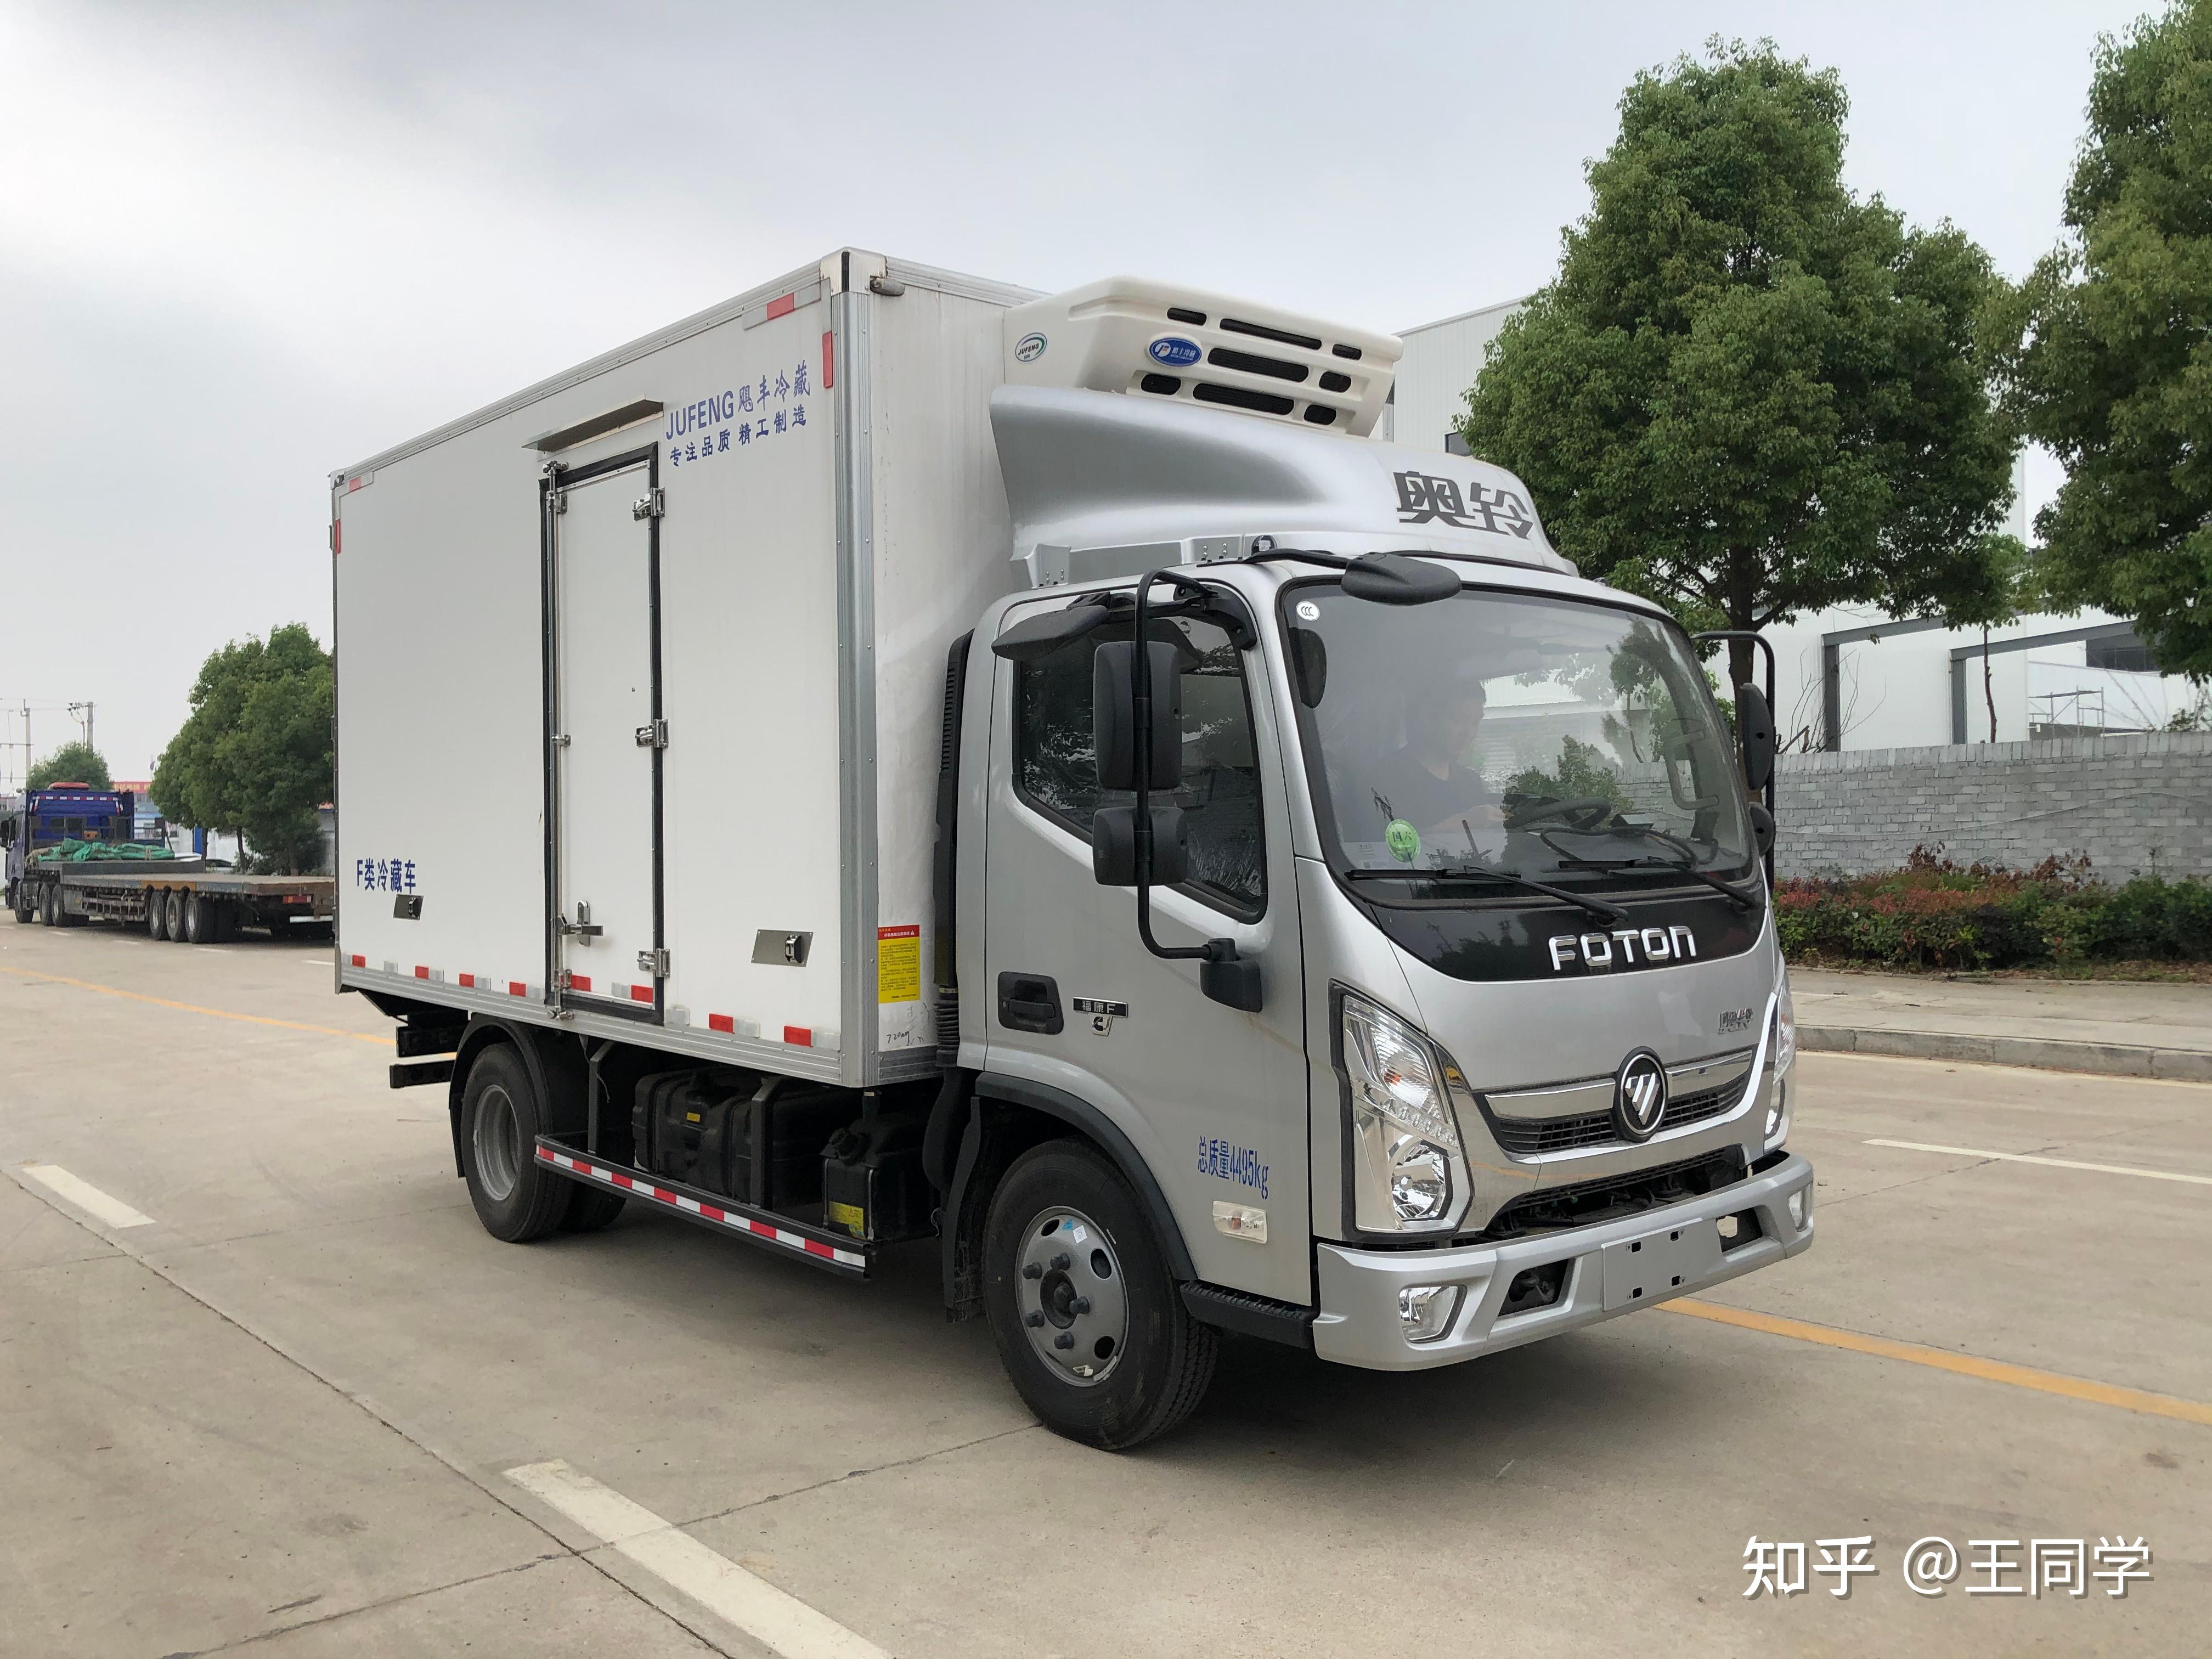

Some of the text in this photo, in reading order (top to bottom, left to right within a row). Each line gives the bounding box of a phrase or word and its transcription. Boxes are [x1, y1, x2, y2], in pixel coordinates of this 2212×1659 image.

[357, 857, 416, 894] F类冷藏车
[1548, 926, 1697, 970] FOTON
